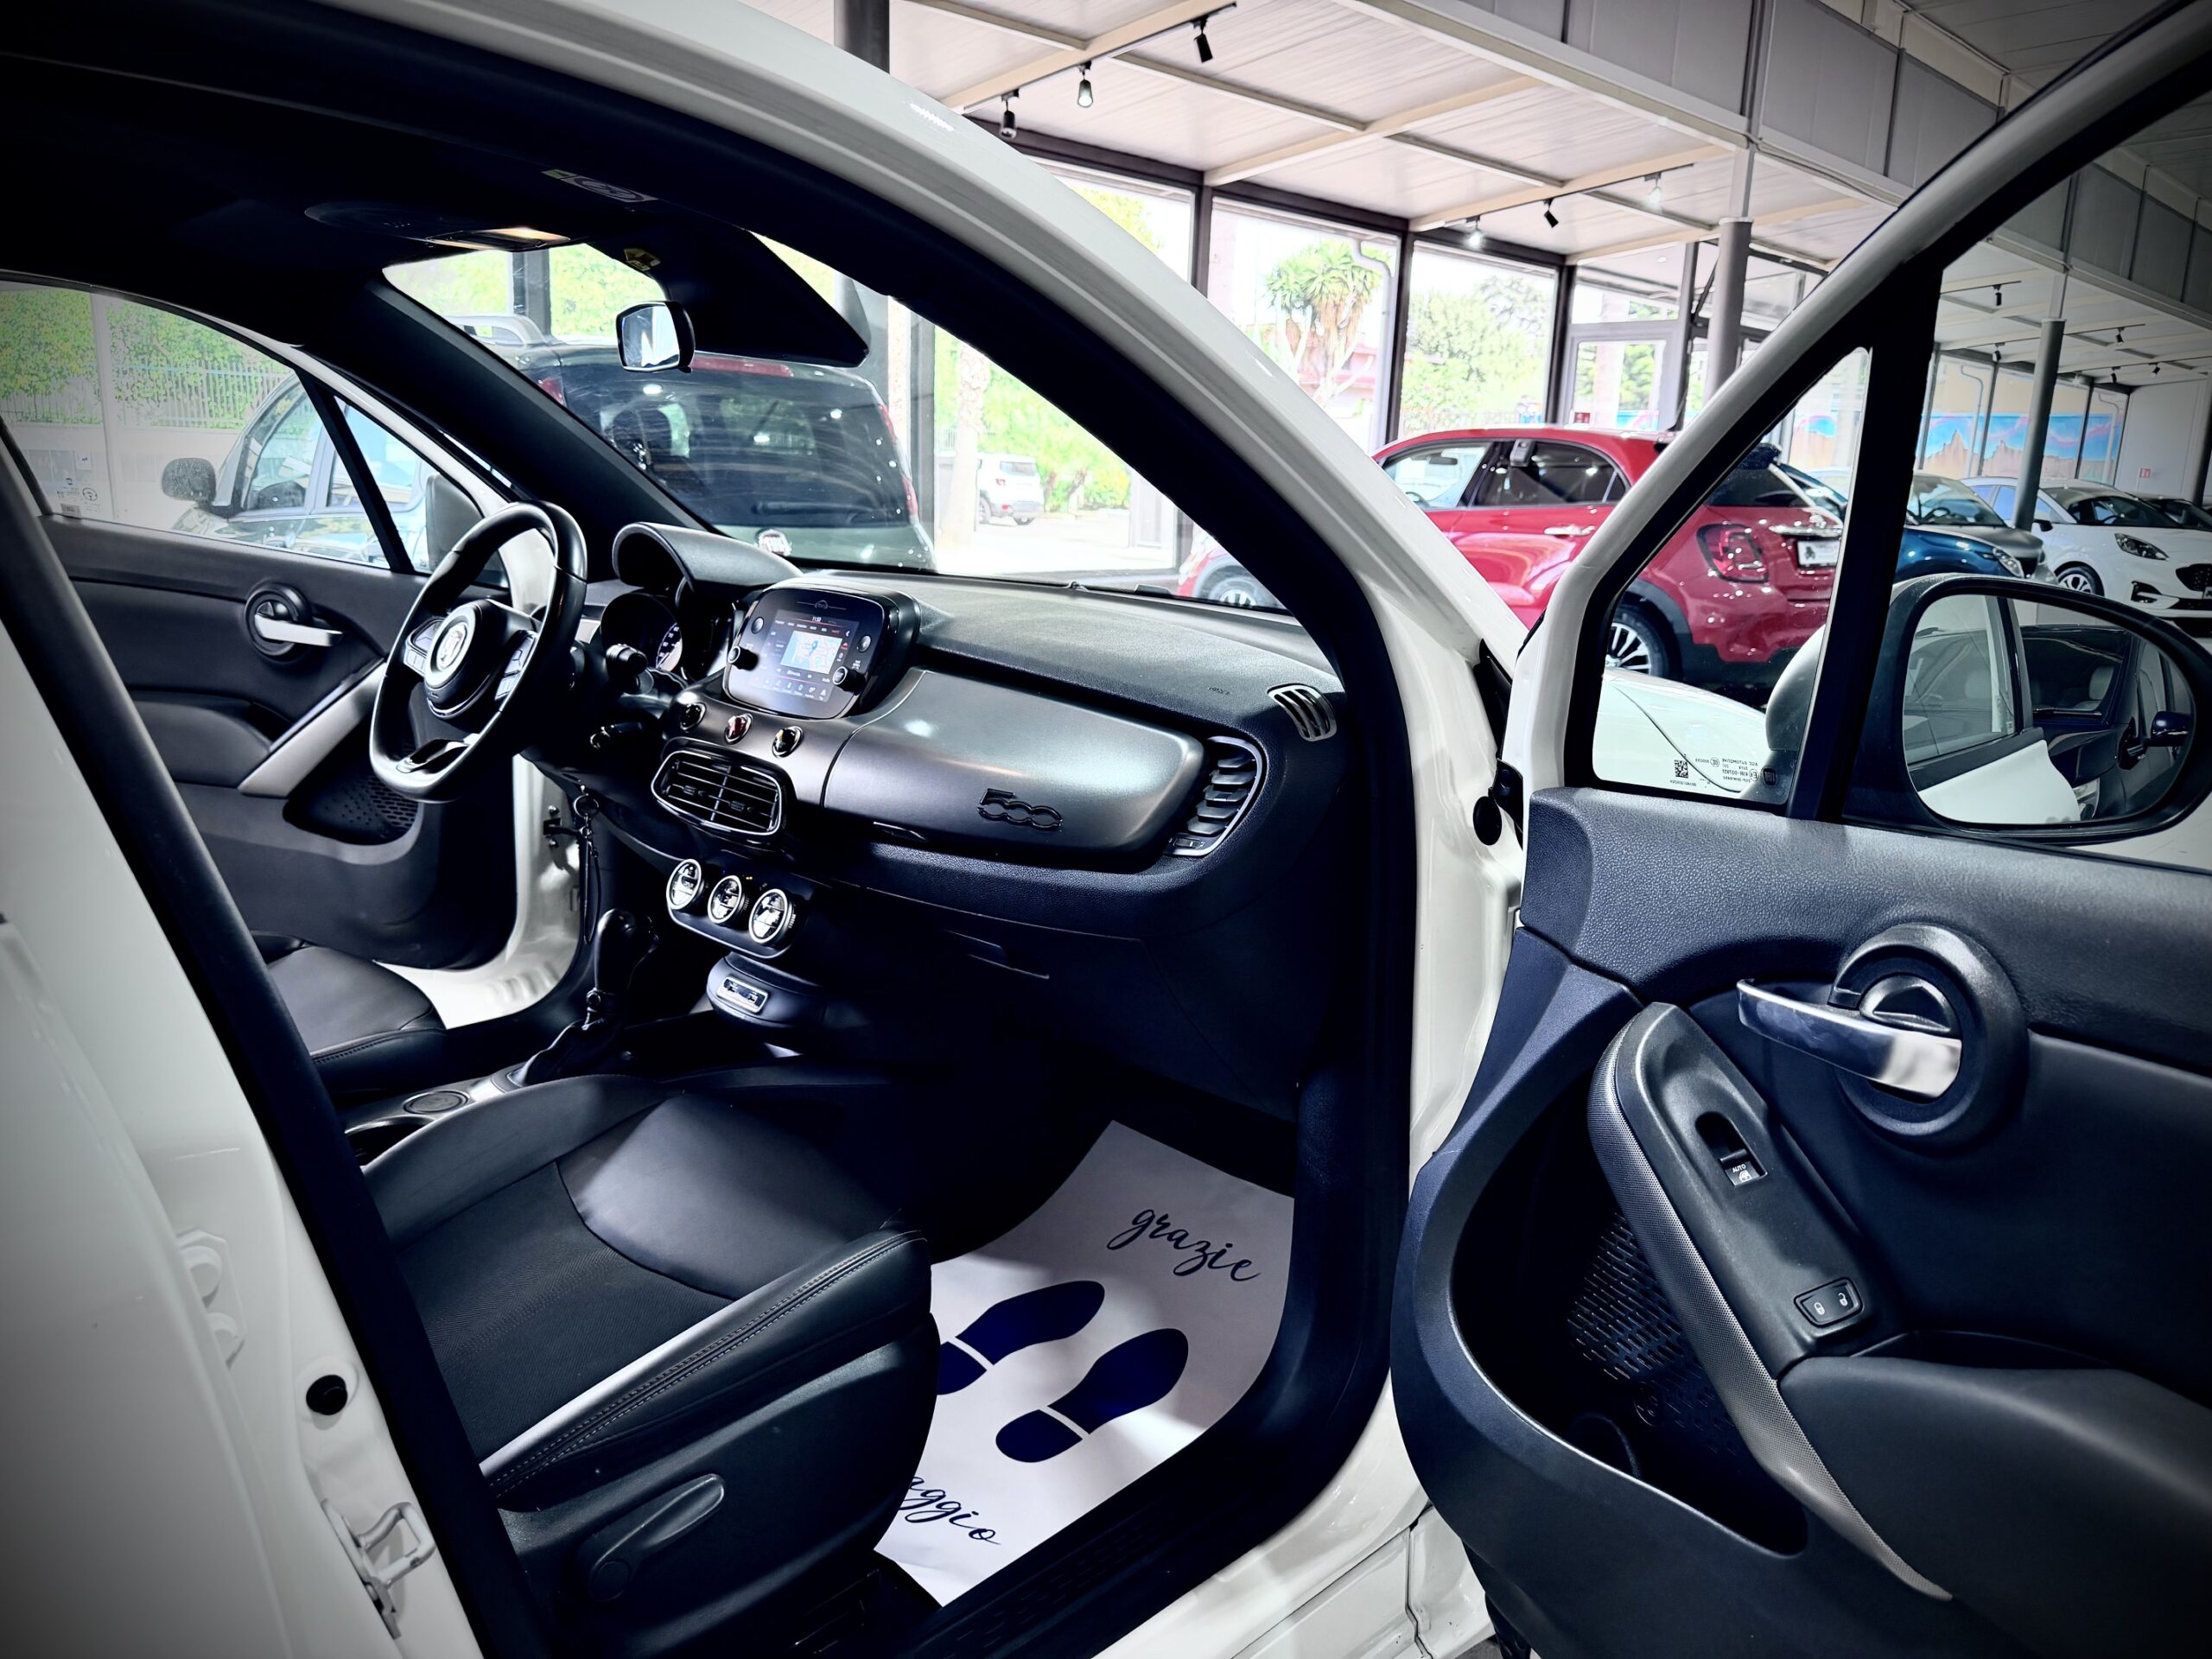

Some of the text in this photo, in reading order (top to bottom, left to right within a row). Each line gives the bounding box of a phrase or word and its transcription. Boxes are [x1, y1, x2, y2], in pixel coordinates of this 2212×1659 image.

[976, 787, 1063, 832] 500
[1732, 1164, 1745, 1173] AUTO
[1106, 1209, 1262, 1281] grazie
